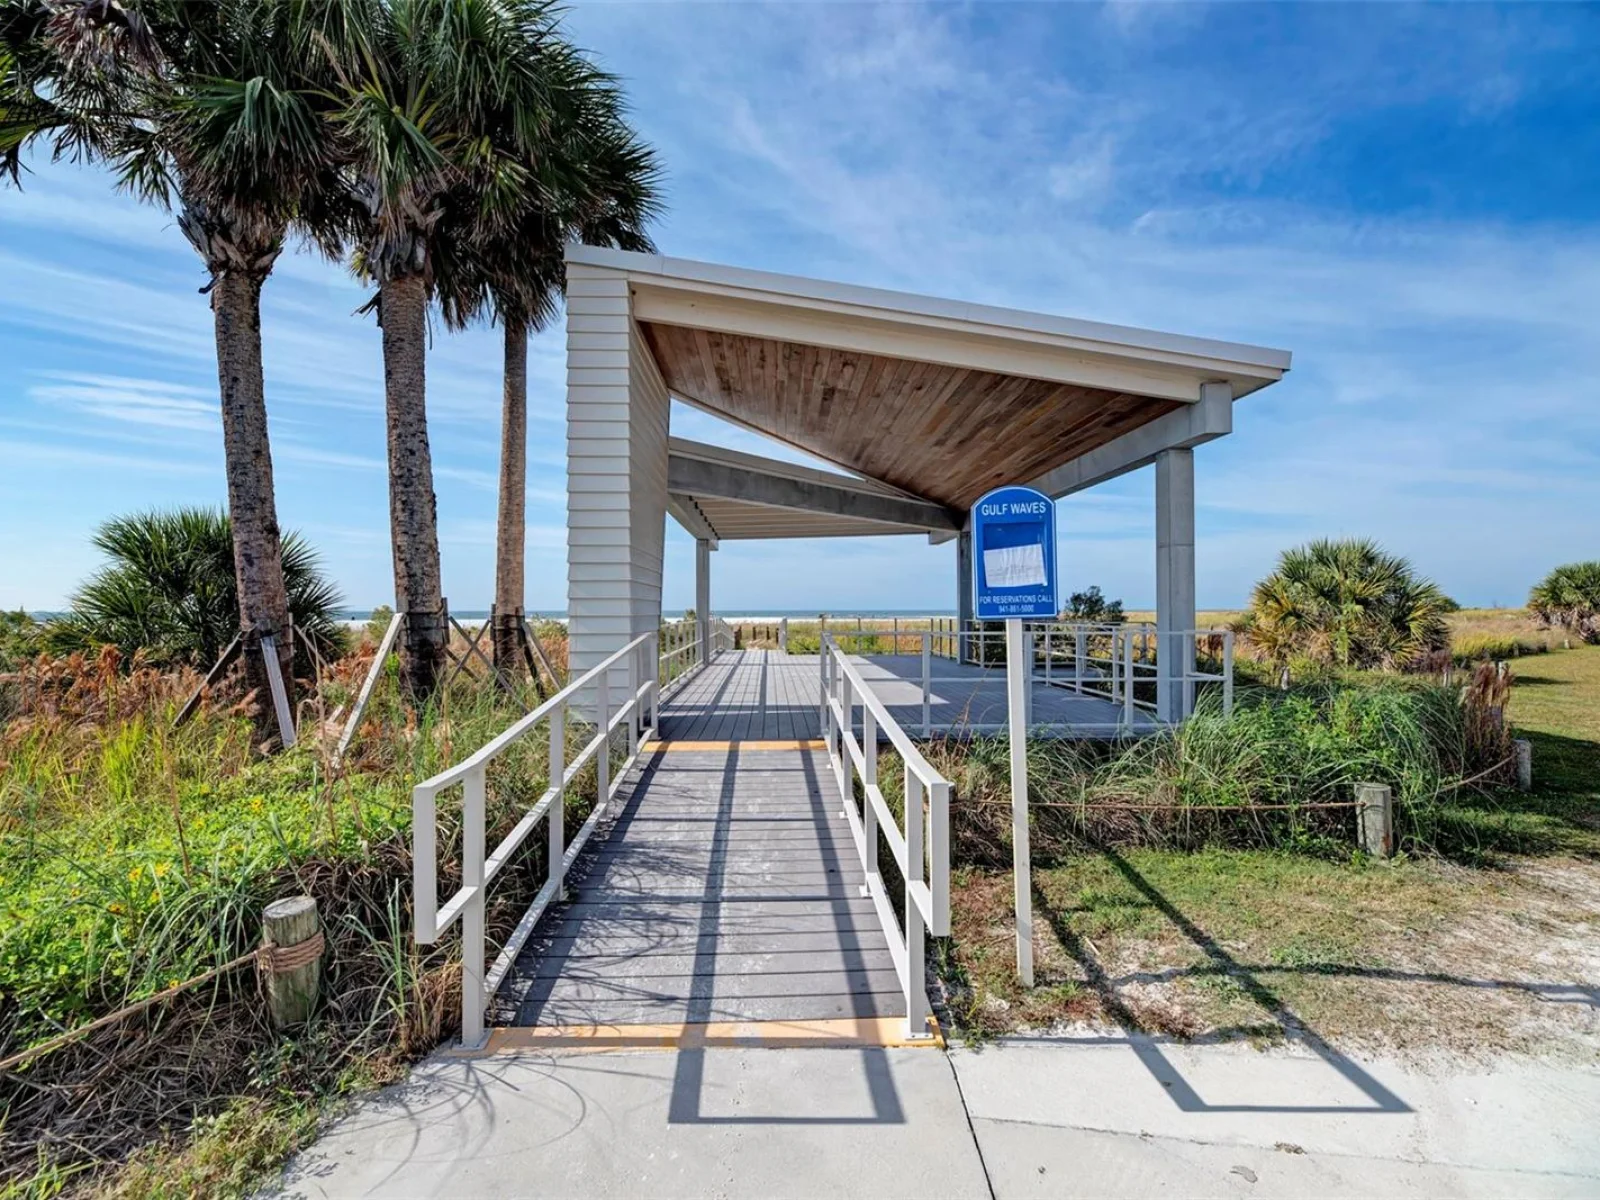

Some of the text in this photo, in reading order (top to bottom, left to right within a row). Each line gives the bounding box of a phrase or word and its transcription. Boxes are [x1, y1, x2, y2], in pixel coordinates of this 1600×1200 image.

[981, 501, 1046, 516] GULF WAVES
[979, 595, 1053, 605] FOR RESERVATIONS CALL
